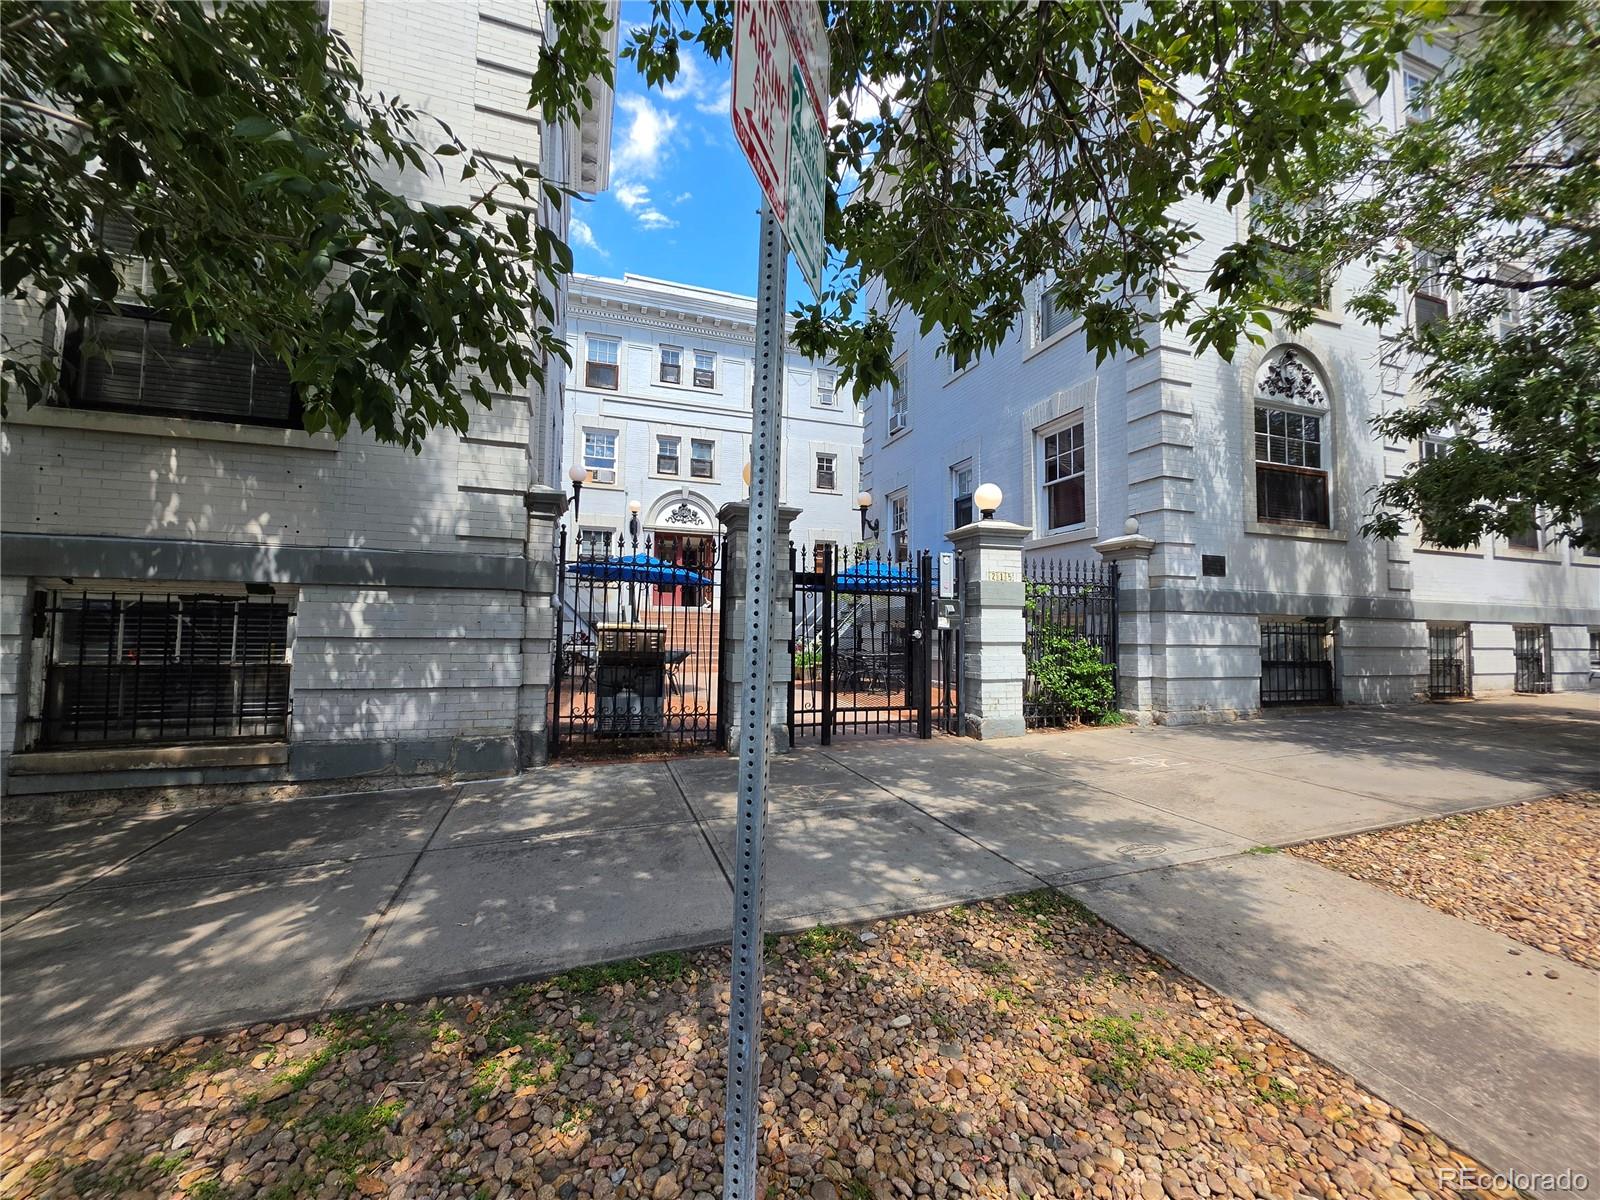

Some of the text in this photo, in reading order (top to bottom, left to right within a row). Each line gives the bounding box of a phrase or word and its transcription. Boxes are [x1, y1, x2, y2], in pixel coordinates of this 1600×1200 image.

[758, 0, 777, 48] NO
[741, 0, 787, 120] PARKING
[754, 63, 775, 120] ANY
[753, 82, 775, 155] TIME
